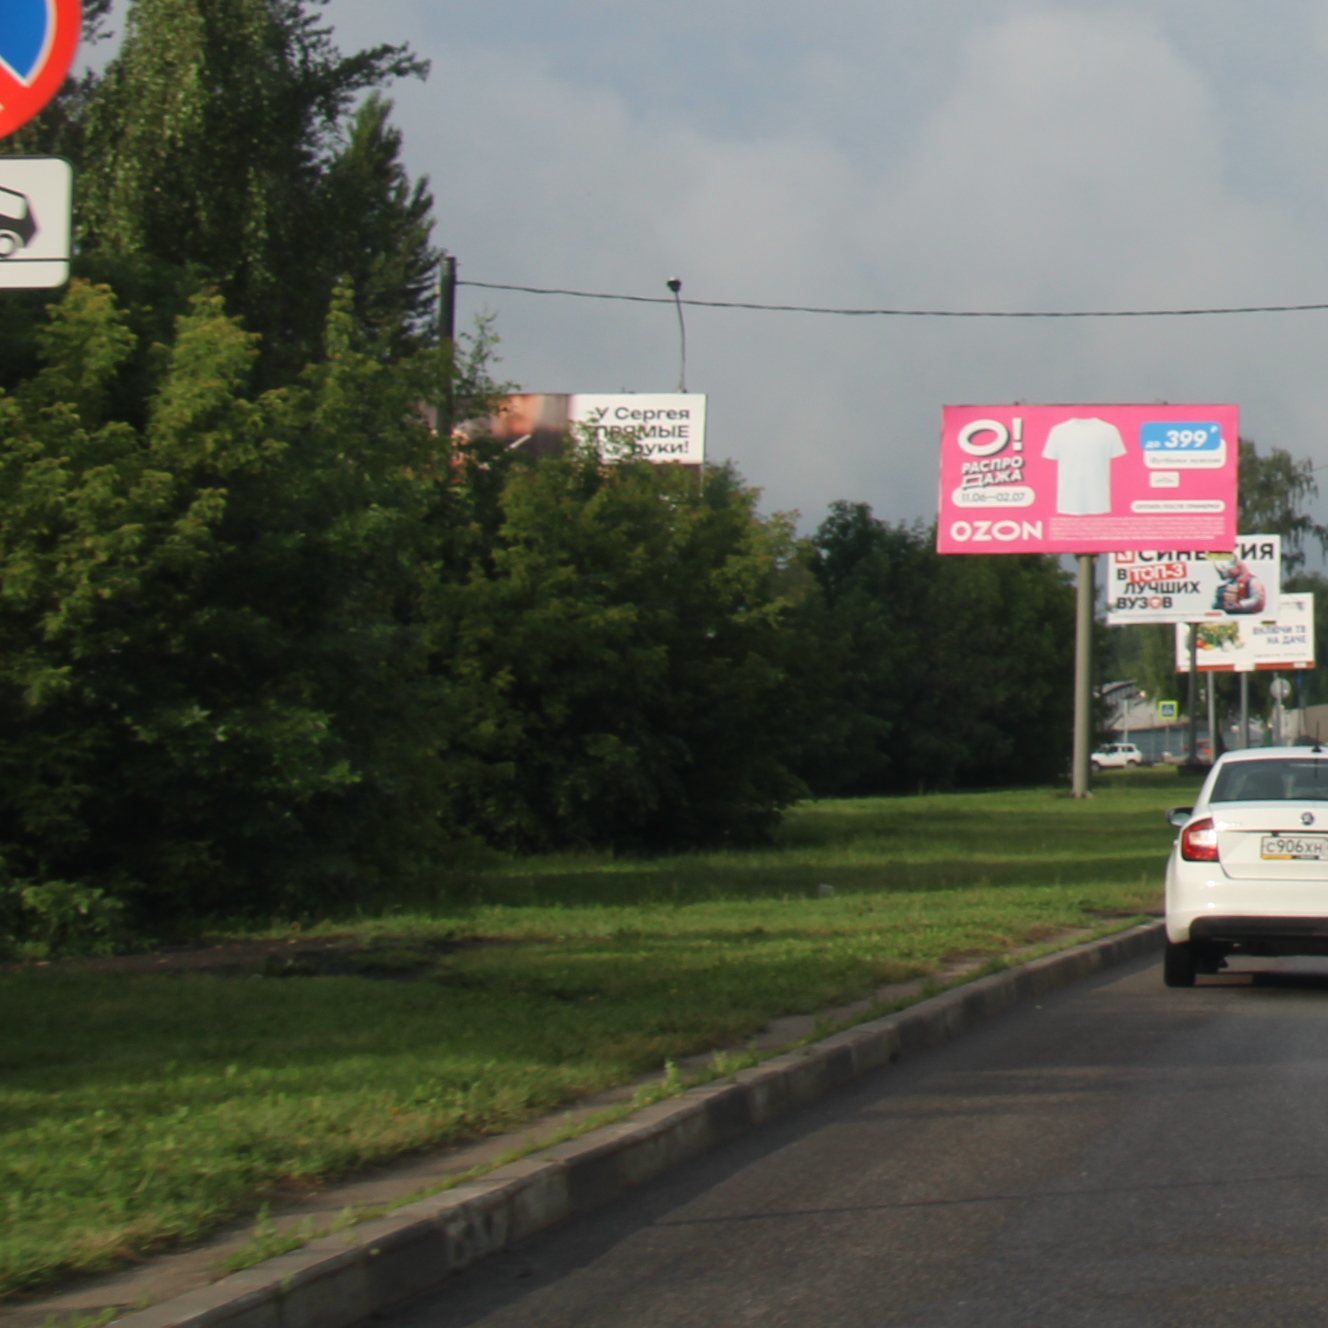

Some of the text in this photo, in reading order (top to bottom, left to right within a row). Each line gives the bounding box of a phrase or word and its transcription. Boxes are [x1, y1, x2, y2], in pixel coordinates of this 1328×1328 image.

[614, 406, 690, 422] Сергея
[1164, 429, 1209, 449] 399
[962, 456, 1024, 475] РАСПРО
[950, 520, 1043, 542] OZON
[1138, 542, 1275, 562] СИНЕИЯ
[1116, 562, 1185, 582] В ТОП-3
[1124, 581, 1201, 594] ЛУЧШИХ
